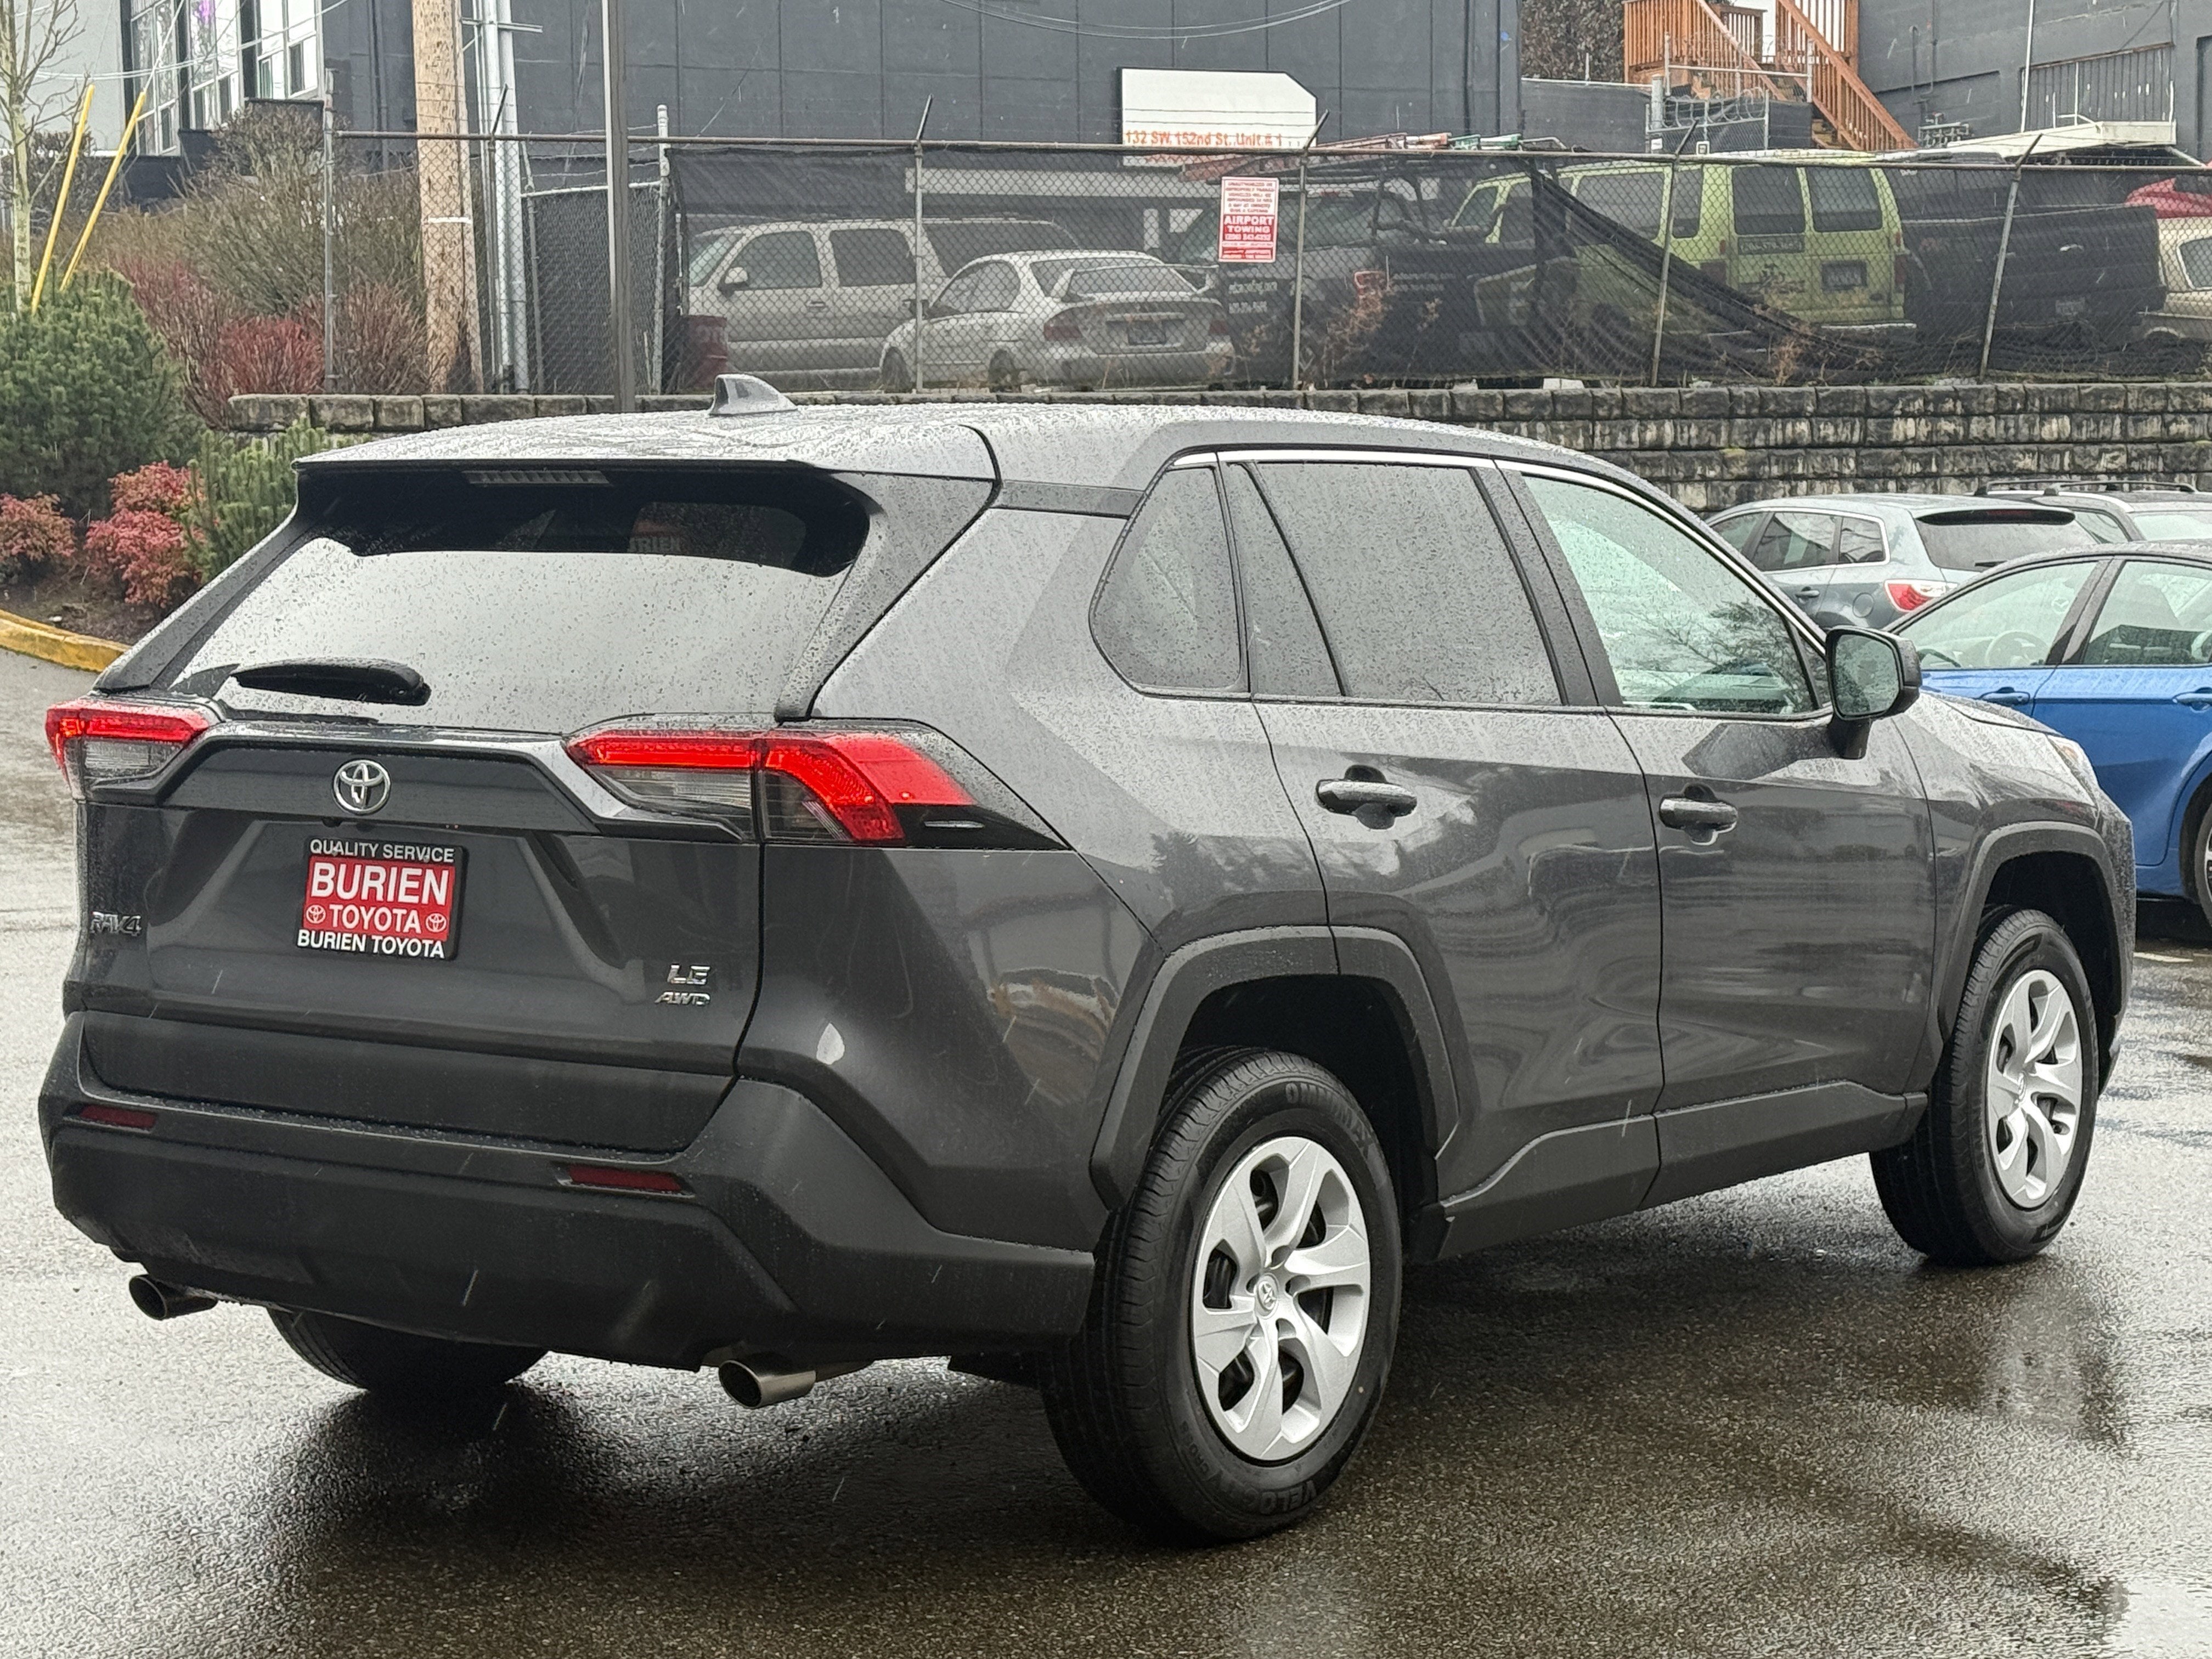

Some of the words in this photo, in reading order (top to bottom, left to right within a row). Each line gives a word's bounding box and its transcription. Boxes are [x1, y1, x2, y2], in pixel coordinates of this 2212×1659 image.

[1126, 130, 1147, 144] 132
[1175, 131, 1211, 146] 152nd
[1236, 133, 1261, 146] Unit
[1224, 215, 1274, 225] AIRPORT
[310, 839, 379, 856] QUALITY
[382, 844, 454, 863] SERVICE
[311, 862, 449, 906] BURIEN
[90, 911, 142, 936] RAV4
[329, 905, 422, 934] TOYOTA
[297, 929, 366, 952] BURIEN
[373, 935, 445, 959] TOYOTA
[667, 964, 710, 985] LE
[654, 991, 710, 1005] AWD
